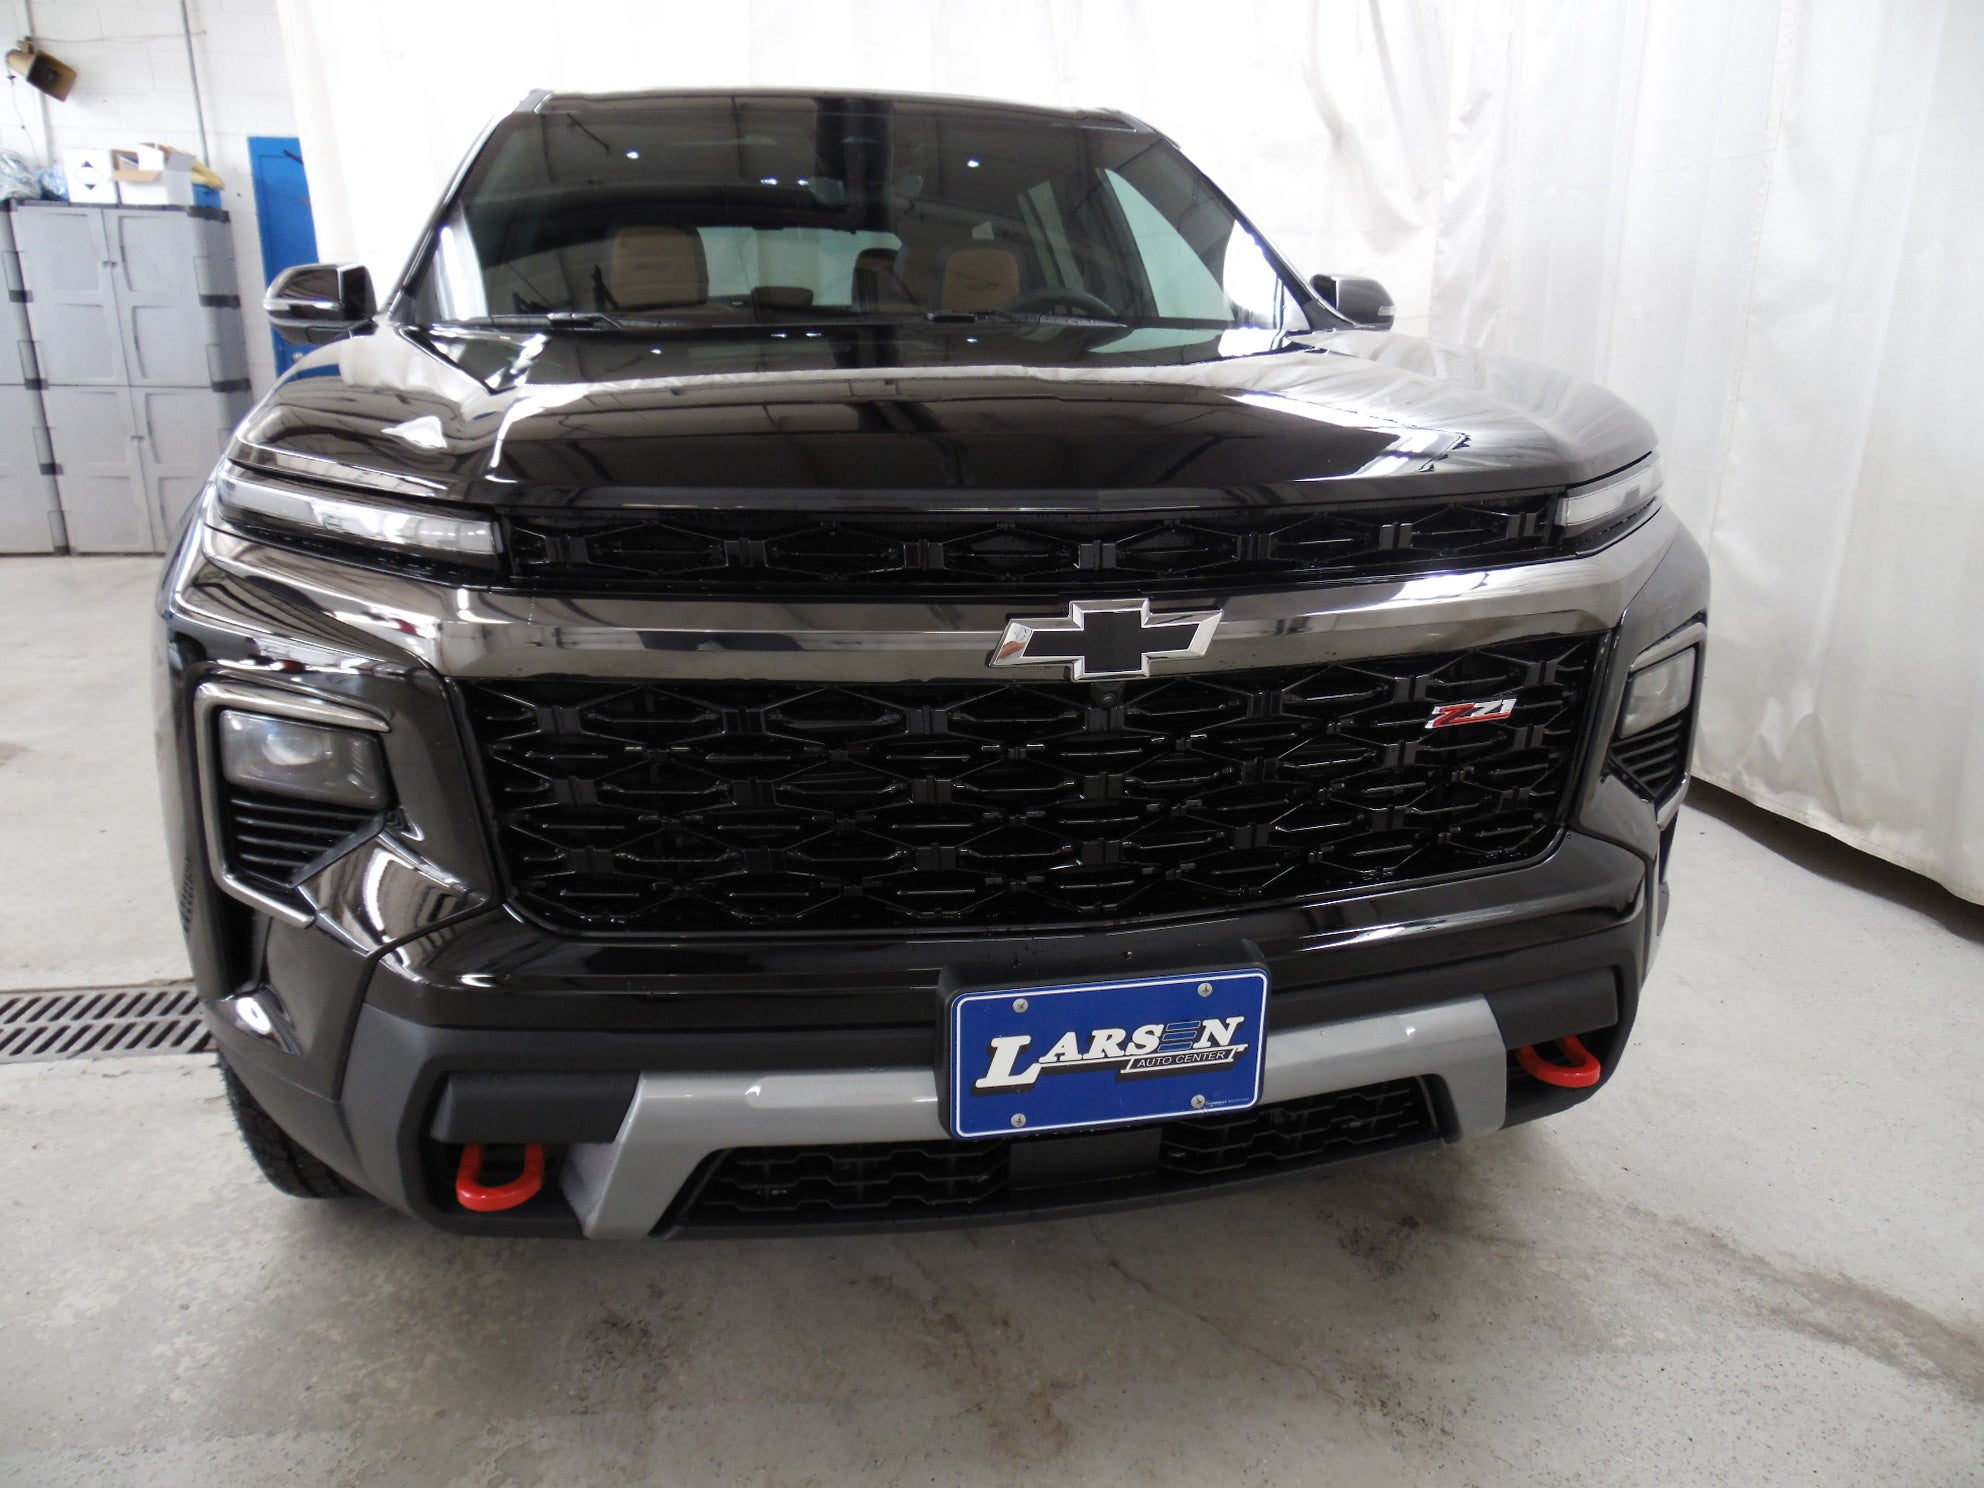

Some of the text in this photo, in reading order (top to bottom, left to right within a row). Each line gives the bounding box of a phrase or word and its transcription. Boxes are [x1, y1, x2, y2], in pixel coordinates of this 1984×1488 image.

[1424, 698, 1517, 728] Z71
[975, 1016, 1245, 1088] LARSEN
[1137, 1050, 1226, 1067] AUTO CENTER
